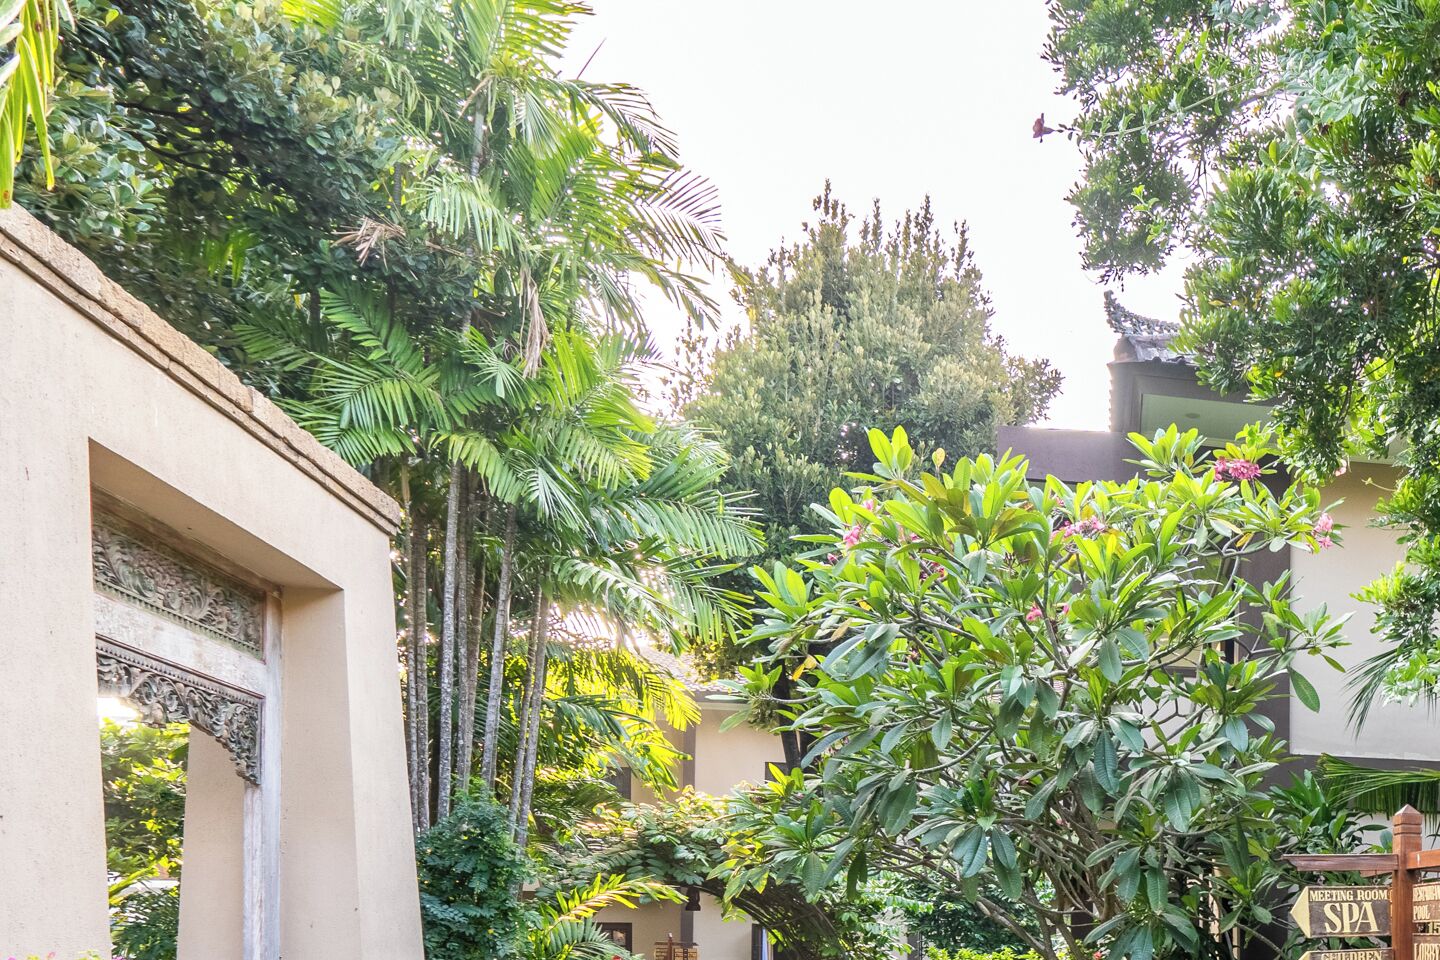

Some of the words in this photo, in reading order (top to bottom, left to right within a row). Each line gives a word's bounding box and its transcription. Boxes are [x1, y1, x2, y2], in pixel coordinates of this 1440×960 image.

[1310, 890, 1353, 902] MEETING
[1357, 889, 1388, 901] ROOM
[1324, 901, 1380, 933] SPA
[1413, 904, 1431, 920] POOL
